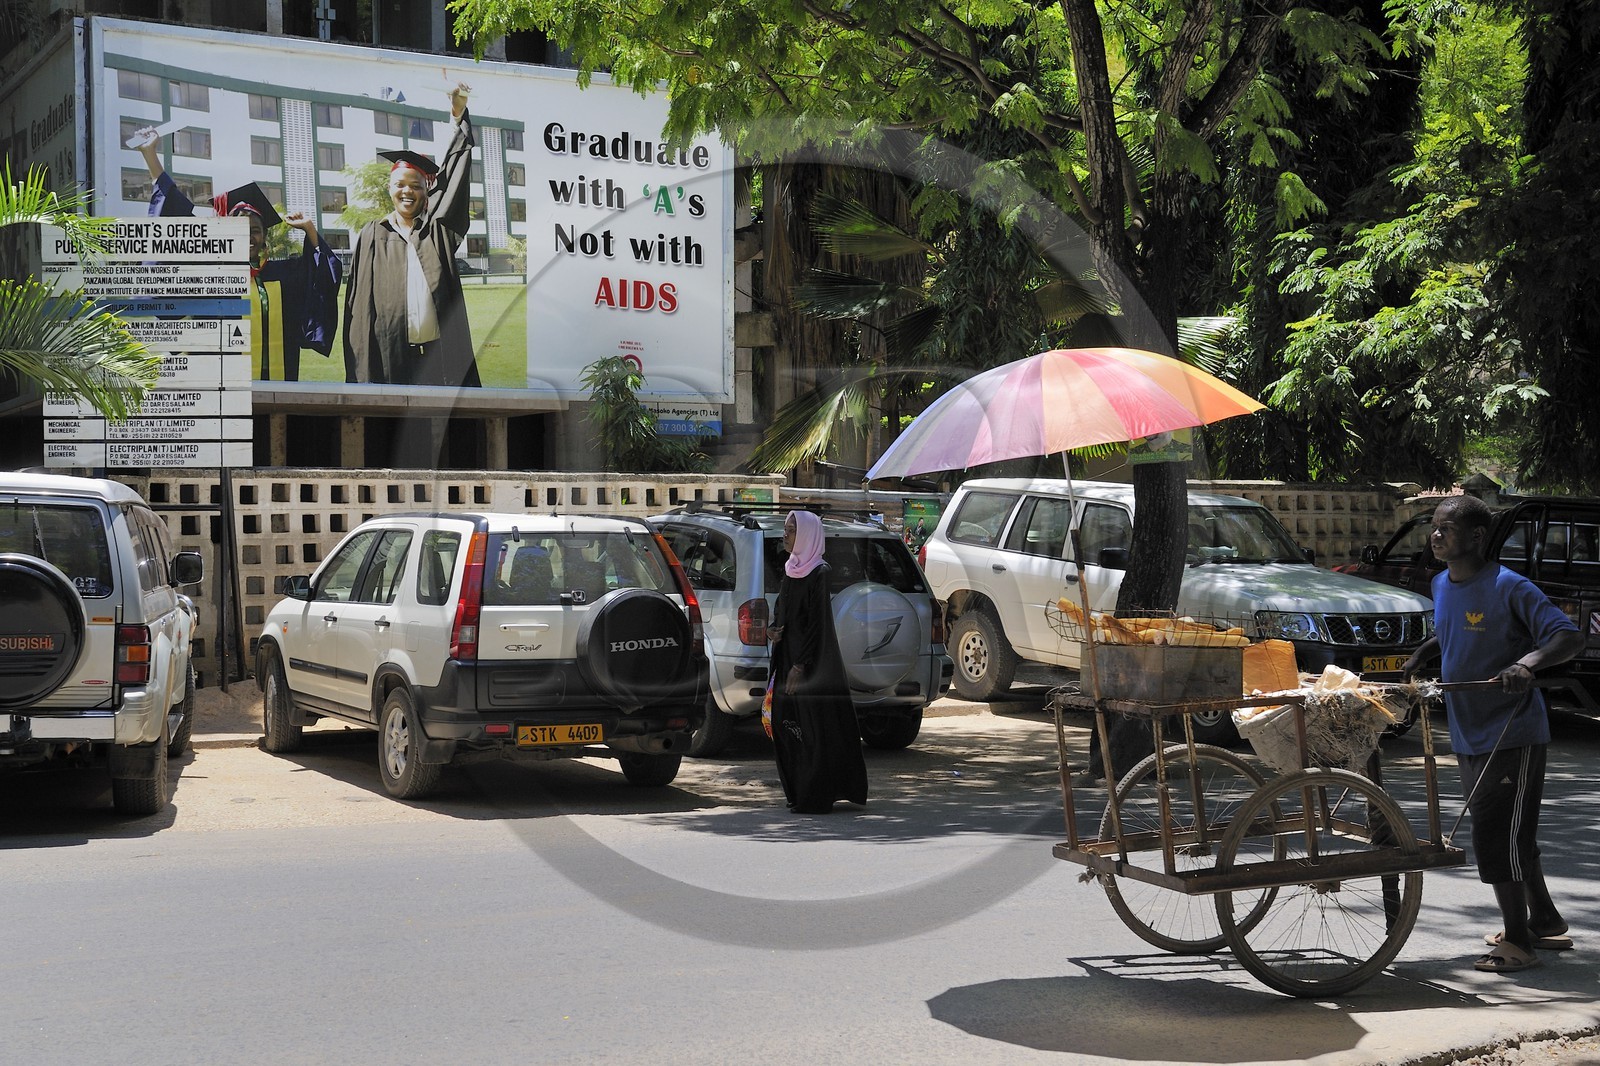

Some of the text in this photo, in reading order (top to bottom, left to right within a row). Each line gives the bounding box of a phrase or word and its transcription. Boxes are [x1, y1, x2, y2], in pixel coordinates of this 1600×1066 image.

[31, 94, 73, 150] Graduate
[543, 122, 709, 168] Graduate
[548, 175, 625, 209] with
[167, 223, 208, 238] OFFICE
[151, 239, 234, 254] MANAGEMENT
[554, 223, 702, 265] Not with
[82, 266, 180, 275] PROPOSED EXTENSION WORKS OF
[83, 276, 112, 285] TANZANIA
[113, 276, 134, 284] GLOBAL
[136, 276, 175, 285] DEVELOPMENT
[176, 276, 203, 284] LEARNING
[204, 276, 225, 284] CENTRE
[83, 287, 100, 295] BLOCK
[101, 287, 105, 295] A
[106, 287, 131, 295] INSTITUTE
[133, 287, 140, 295] OF
[165, 287, 204, 295] MANAGEMENT
[594, 276, 678, 312] AIDS
[137, 303, 161, 311] PERMIT
[155, 321, 191, 329] ARCHITECTS
[192, 321, 217, 329] LIMITED
[159, 357, 188, 365] LIMITED
[671, 407, 699, 416] Agencies
[699, 409, 708, 417] (T)
[671, 423, 687, 432] 300
[109, 445, 158, 453] ELECTRIPLAN
[73, 577, 97, 588] GT
[610, 637, 679, 653] HONDA
[1370, 658, 1389, 671] STK
[530, 725, 599, 742] STK 4409
